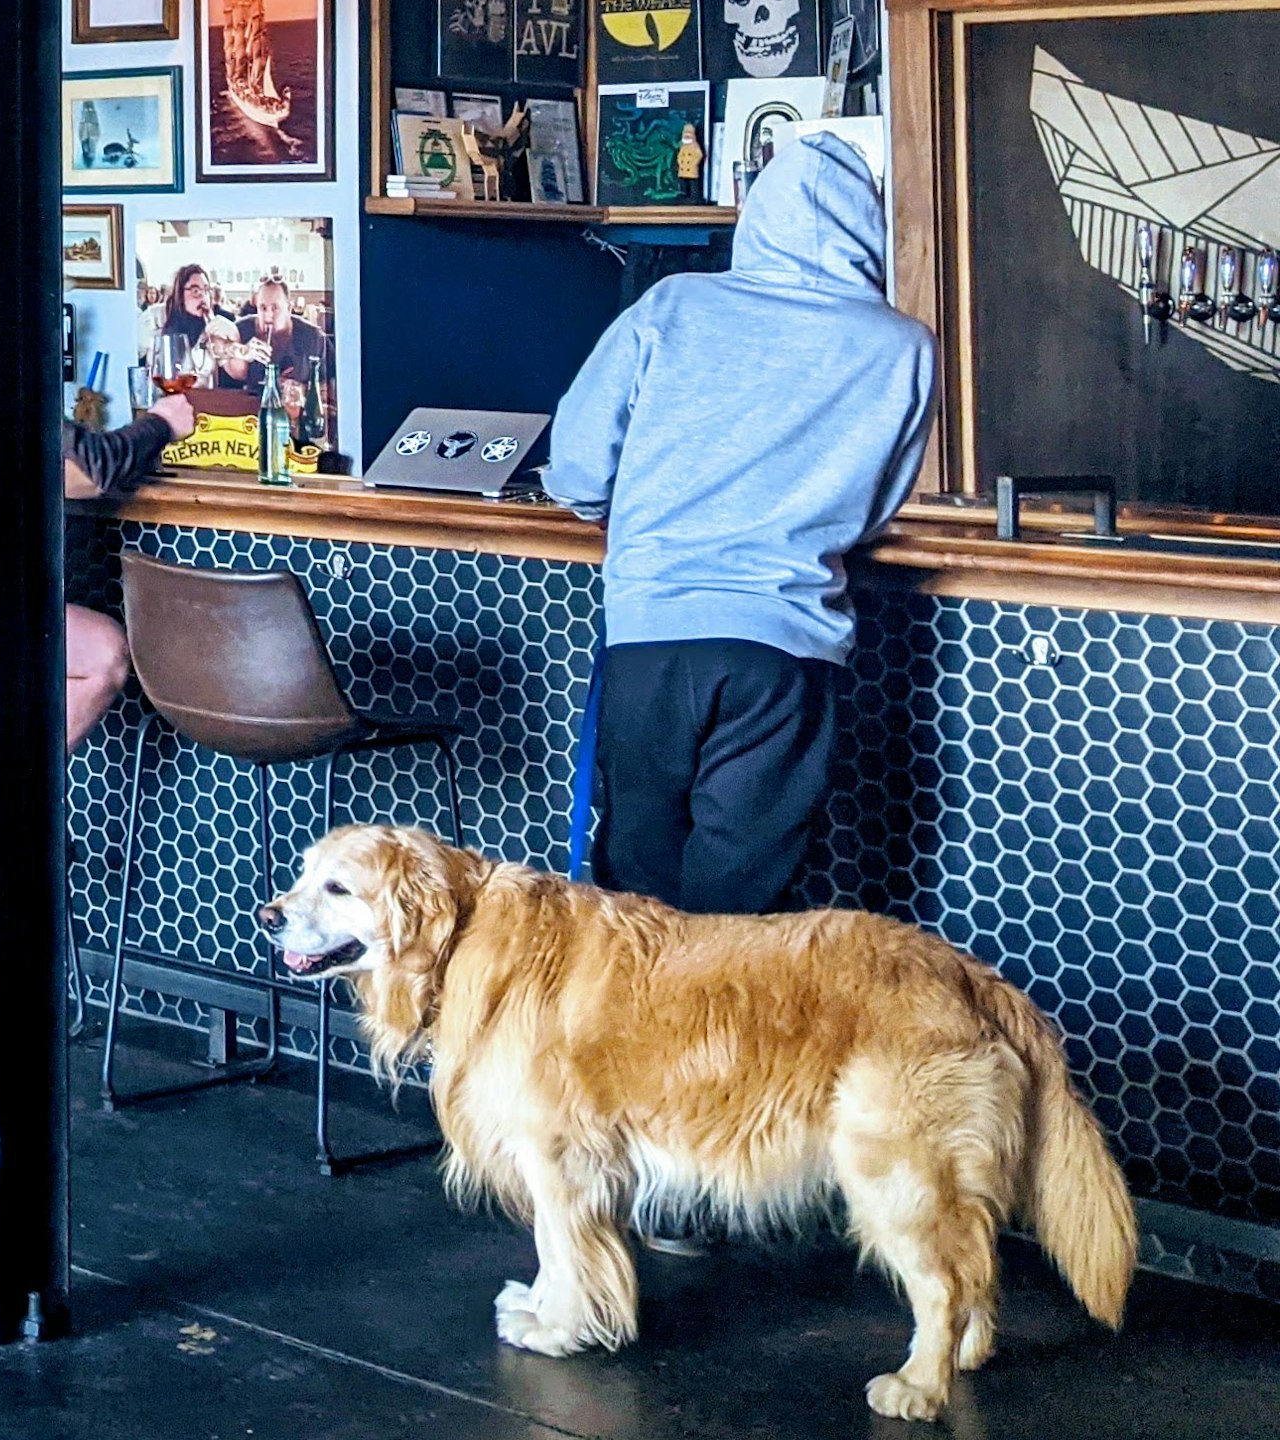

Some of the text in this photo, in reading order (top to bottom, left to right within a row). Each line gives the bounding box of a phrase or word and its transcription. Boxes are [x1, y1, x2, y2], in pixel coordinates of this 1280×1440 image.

[517, 20, 578, 59] AVL
[163, 439, 261, 464] SIERRA NEV
